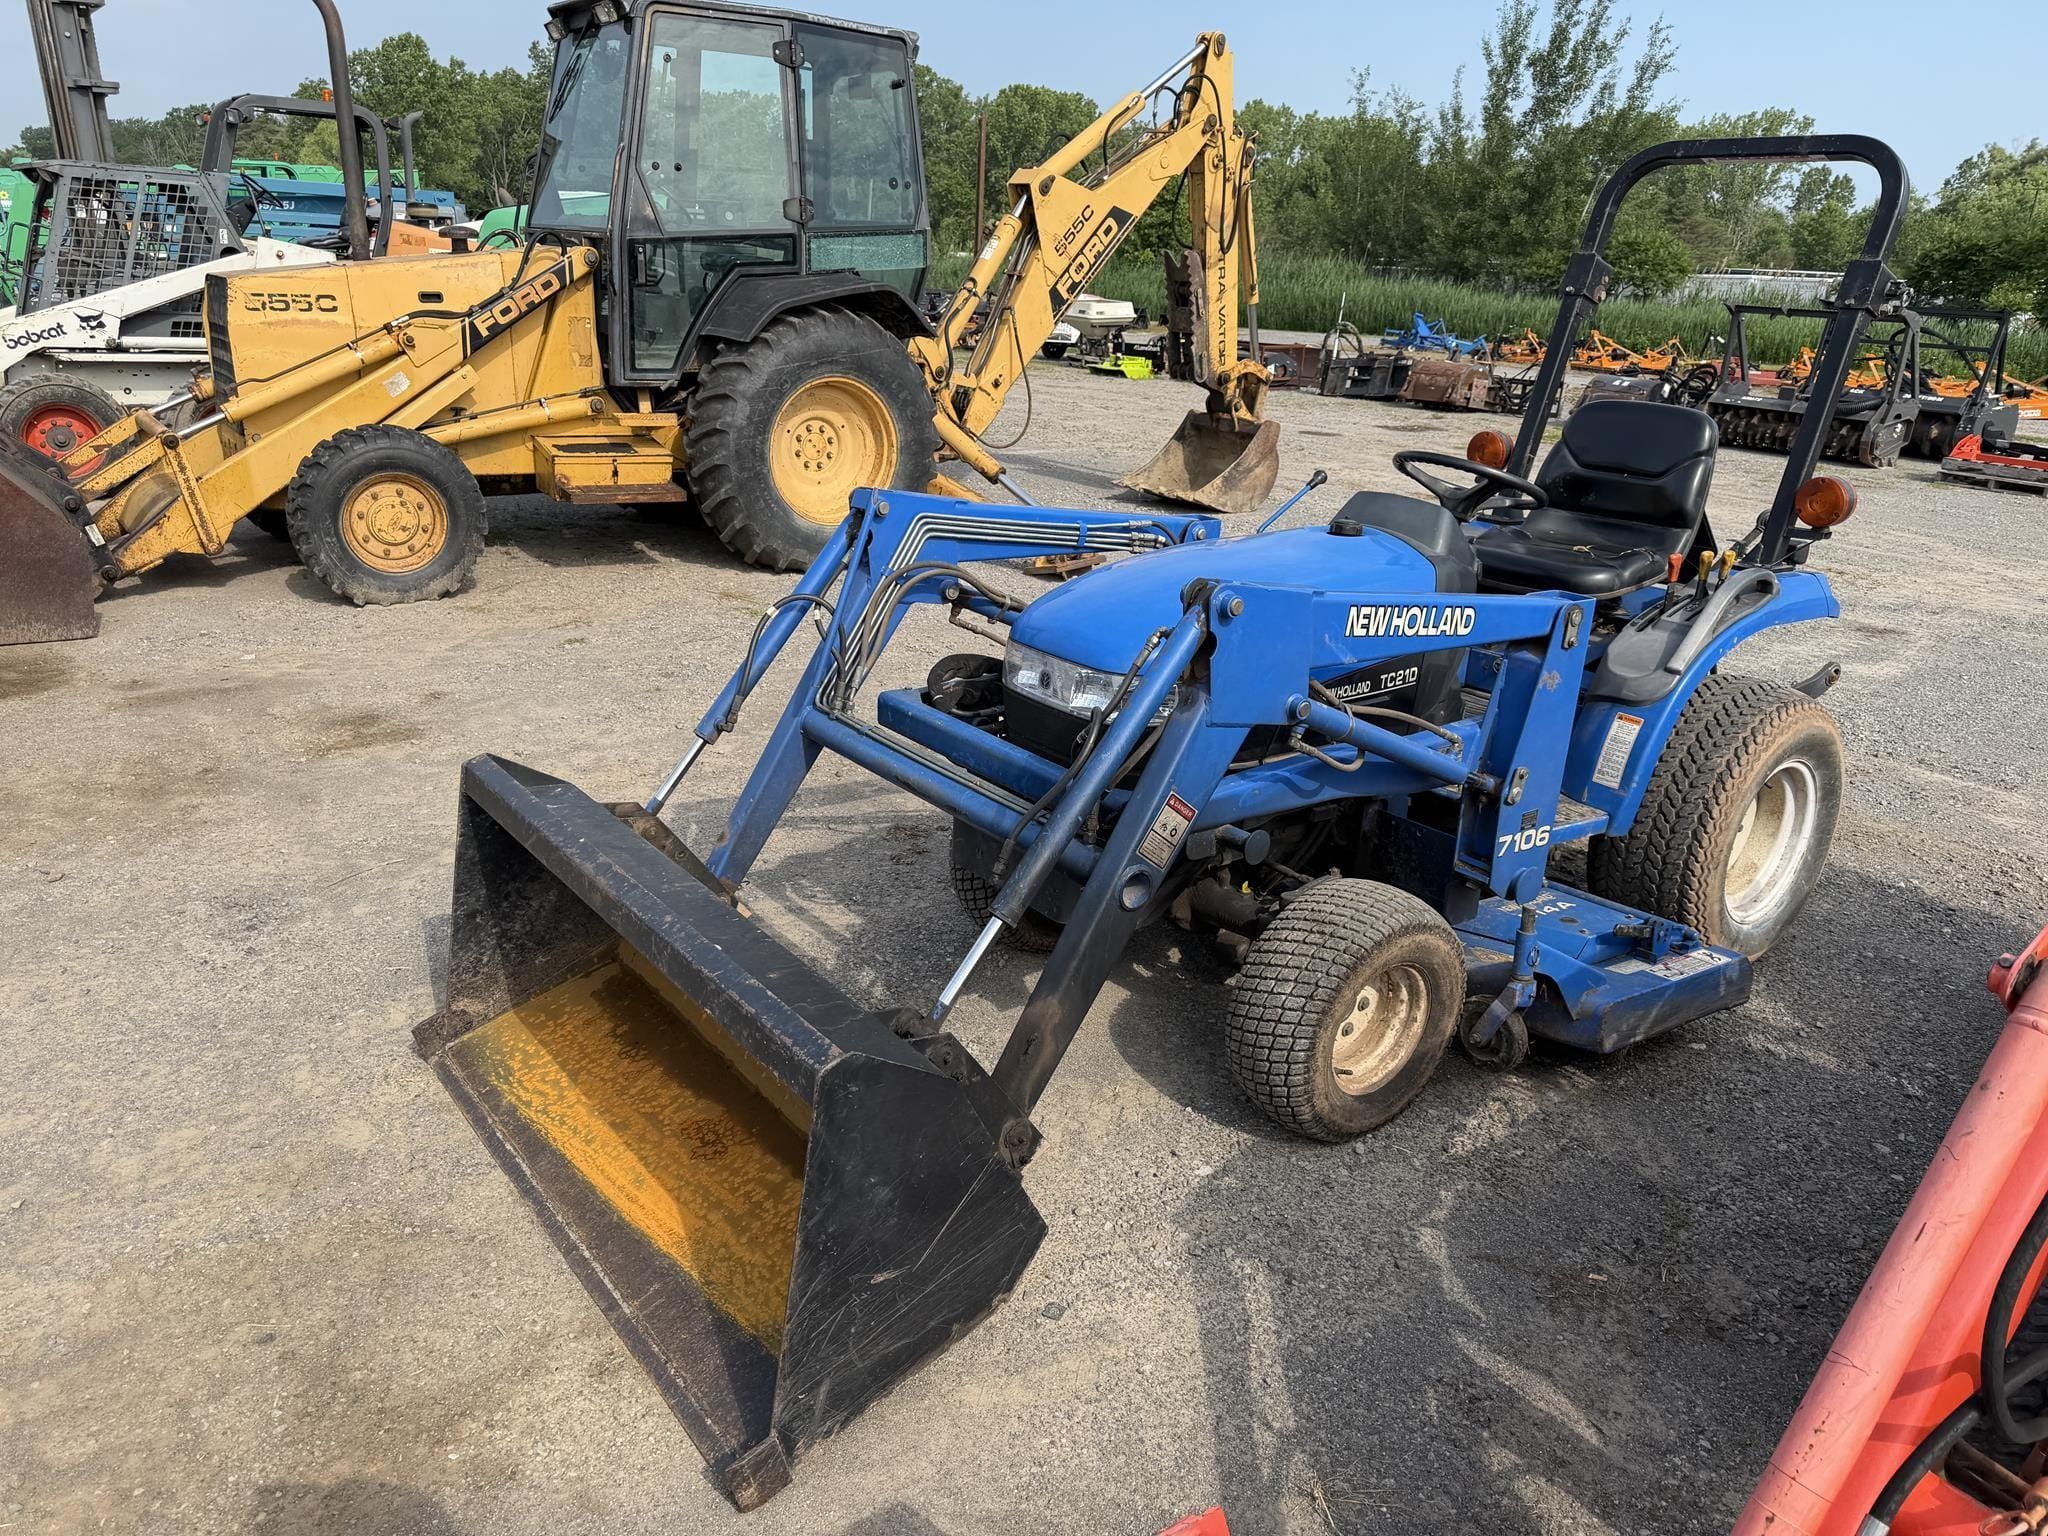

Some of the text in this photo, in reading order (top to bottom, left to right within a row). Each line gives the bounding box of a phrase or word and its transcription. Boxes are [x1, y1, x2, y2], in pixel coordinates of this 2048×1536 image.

[1054, 205, 1095, 257] 555C
[1056, 217, 1119, 302] FORD
[244, 291, 339, 313] 555C
[473, 272, 561, 338] FORD
[1, 322, 68, 350] bobcat
[1345, 605, 1476, 636] NEW HOLLAND
[1336, 680, 1371, 699] HOLLAND
[1380, 666, 1419, 689] TC21D
[1174, 800, 1194, 818] DANGER
[1497, 825, 1552, 857] 7106
